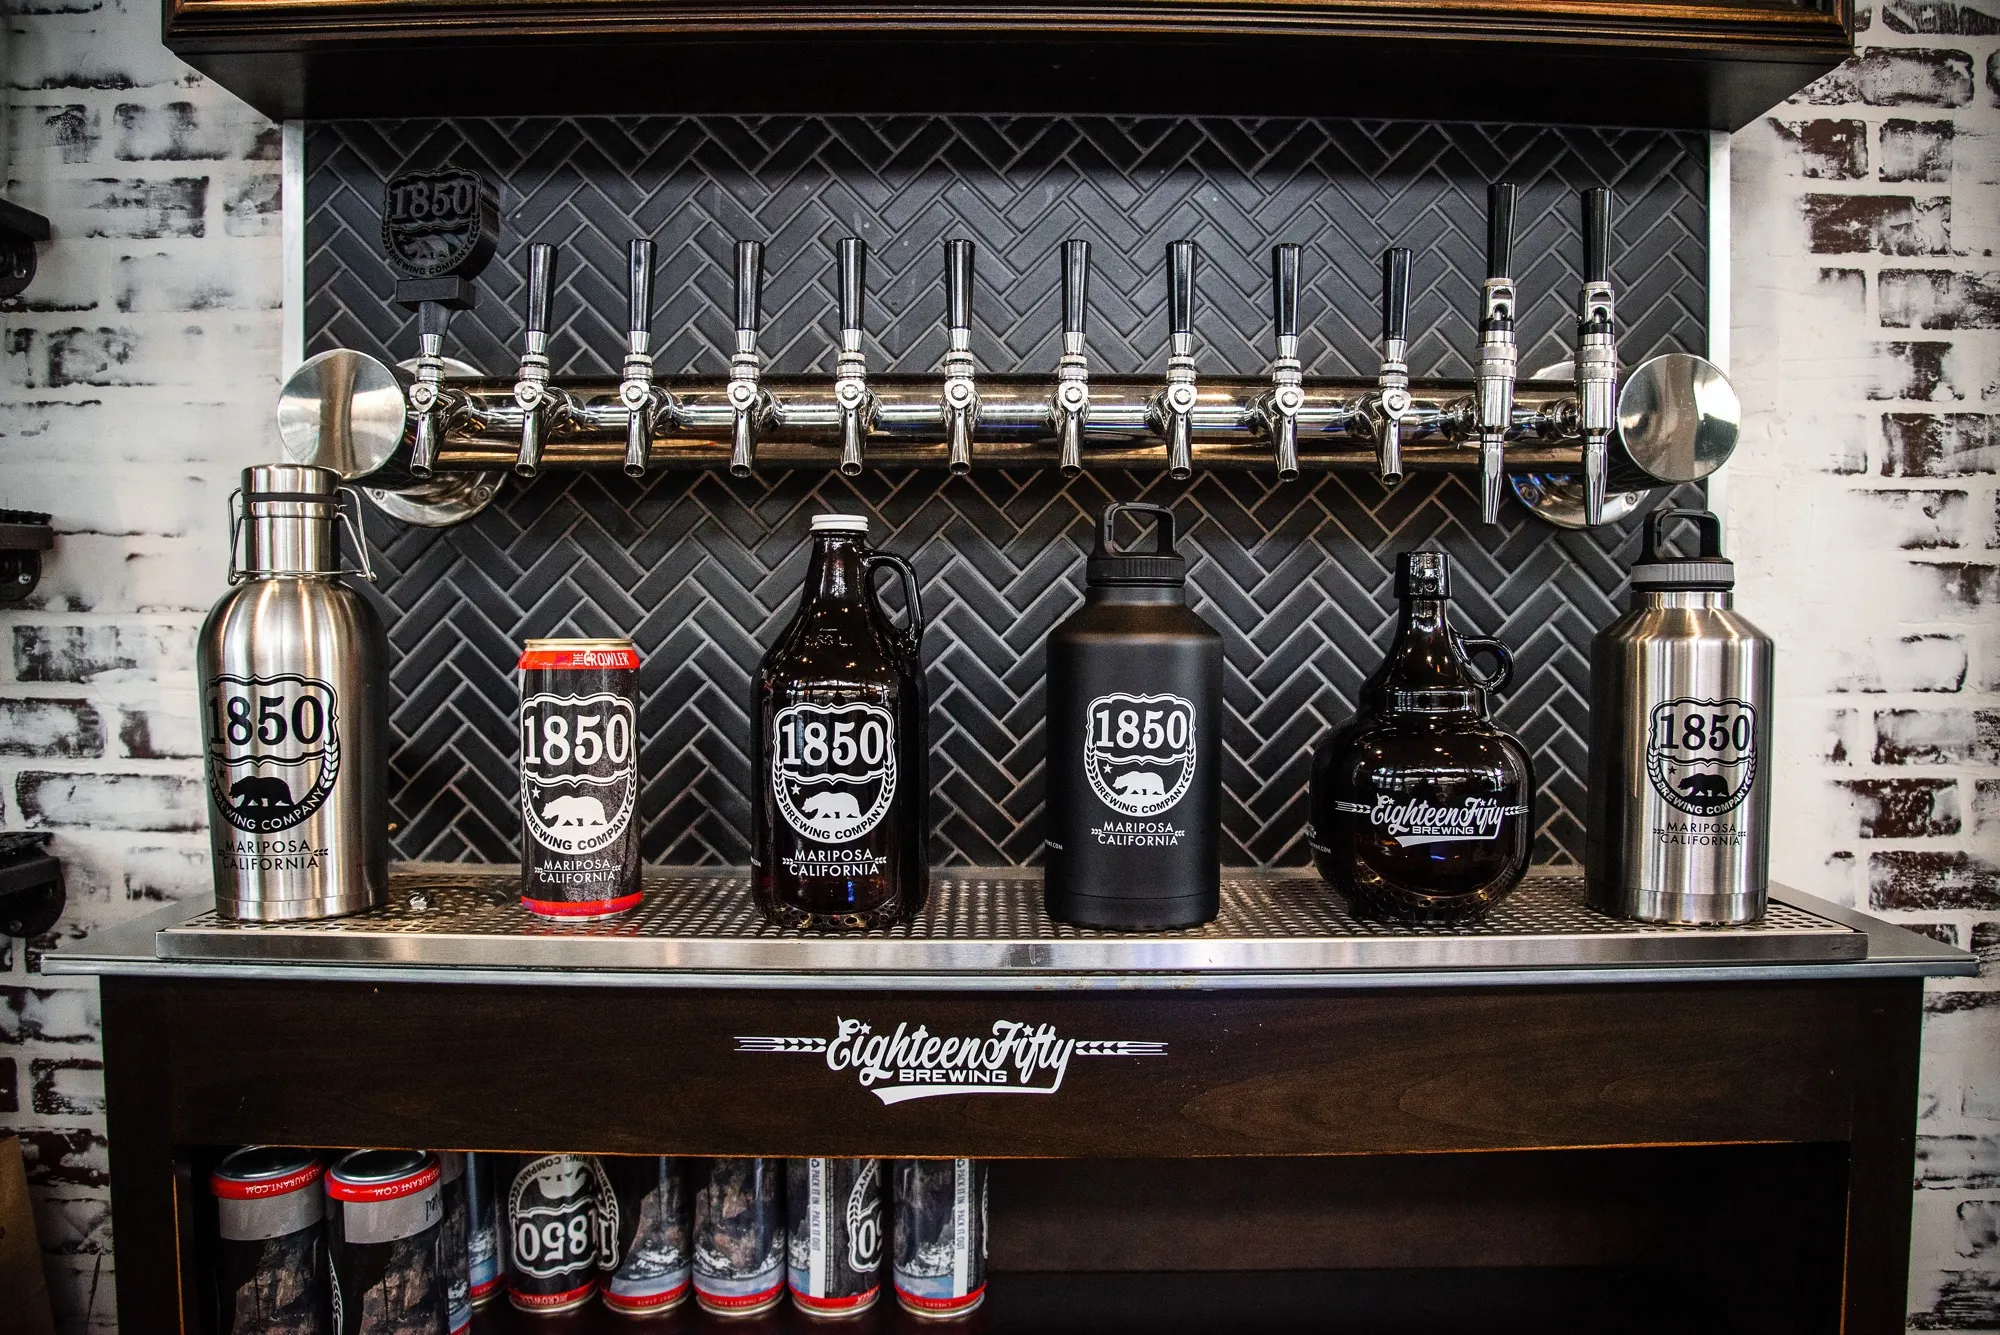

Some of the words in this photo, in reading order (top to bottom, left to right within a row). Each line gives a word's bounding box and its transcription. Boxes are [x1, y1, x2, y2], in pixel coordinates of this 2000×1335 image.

[391, 178, 473, 219] 1850
[388, 247, 426, 275] BREWING
[429, 243, 470, 274] COMPANY
[573, 653, 583, 666] THE
[208, 695, 324, 746] 1850
[1096, 709, 1187, 749] 1850
[524, 713, 630, 766] 1850
[1660, 713, 1750, 751] 1850
[782, 721, 884, 766] 1850
[1094, 778, 1138, 814] BREWING
[1141, 781, 1186, 814] COMPANY
[1657, 781, 1703, 814] BREWING
[1706, 784, 1749, 815] COMPANY
[214, 788, 257, 831] BREWING
[261, 788, 325, 831] COMPANY
[1370, 793, 1463, 835] Eighteen
[1460, 796, 1505, 840] Fifty
[525, 807, 573, 850] BREWING
[577, 805, 630, 850] COMPANY
[782, 802, 830, 840] BREWING
[834, 801, 886, 840] COMPANY
[1103, 821, 1174, 833] MARIPOSA
[1666, 822, 1737, 833] MARIPOSA
[1098, 833, 1178, 846] CALIFORNIA
[1412, 826, 1474, 835] BREWING
[1660, 833, 1740, 846] CALIFORNIA
[224, 839, 311, 854] MARIPOSA
[794, 848, 874, 862] MARIPOSA
[222, 856, 319, 871] CALIFORNIA
[543, 859, 611, 871] MARIPOSA
[789, 863, 879, 877] CALIFORNIA
[540, 871, 616, 884] CALIFORNIA
[826, 1015, 988, 1086] Eighteen
[984, 1019, 1076, 1092] Fifty
[899, 1069, 1008, 1084] BREWING
[516, 1156, 562, 1188] COMPANY
[811, 1169, 821, 1187] PACK
[956, 1169, 966, 1187] PACK
[811, 1210, 821, 1227] PACK
[956, 1210, 966, 1227] PACK
